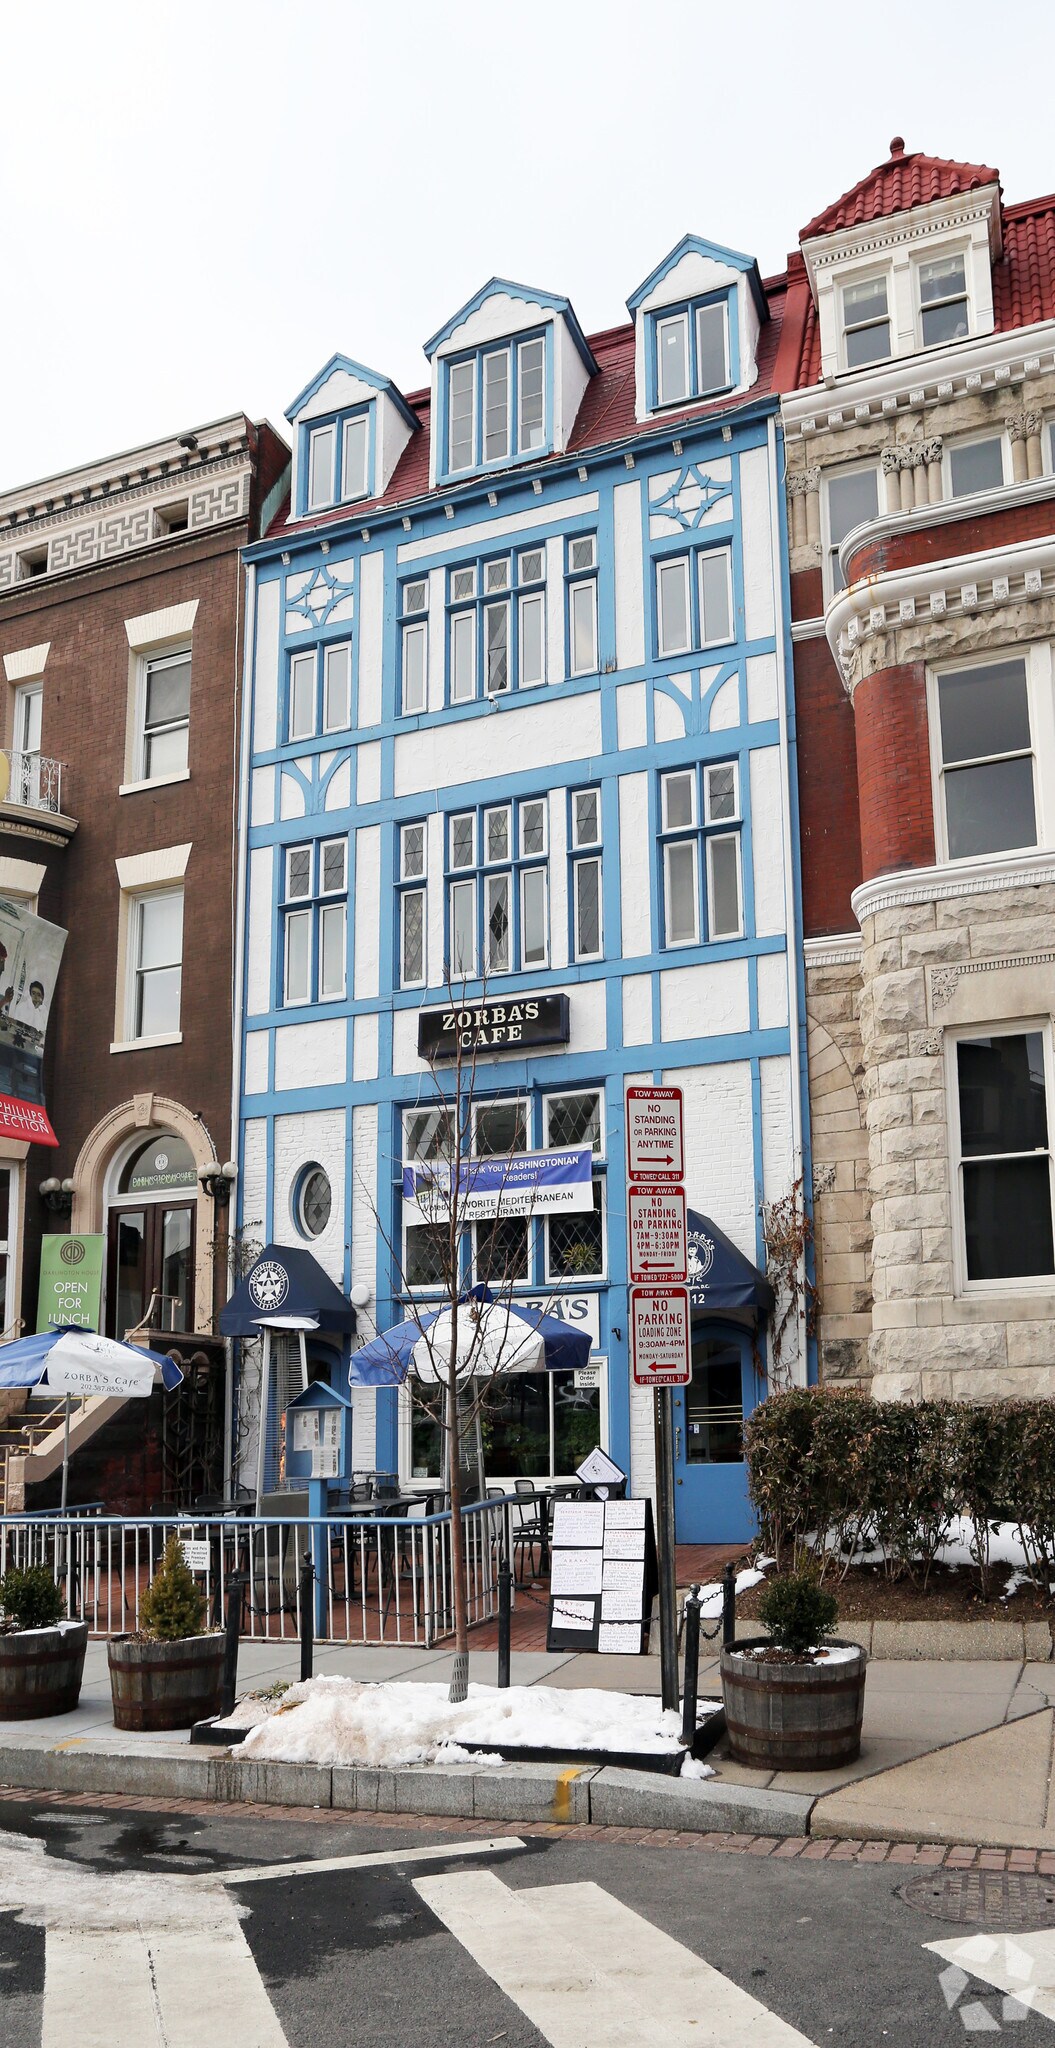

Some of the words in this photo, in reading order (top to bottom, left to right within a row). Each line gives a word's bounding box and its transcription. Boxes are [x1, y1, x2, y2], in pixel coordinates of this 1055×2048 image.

[442, 1002, 539, 1031] ZORBA'S
[459, 1024, 522, 1048] CAFE
[647, 1104, 661, 1113] NO
[634, 1115, 675, 1124] STANDING
[644, 1127, 677, 1136] PARKING
[637, 1140, 674, 1149] ANYTIME
[487, 1164, 503, 1173] You
[504, 1155, 579, 1171] WASHINGTONIAN
[499, 1192, 574, 1207] MEDITERRANEAN
[651, 1198, 663, 1207] NO
[638, 1209, 677, 1218] STANDING
[633, 1220, 644, 1229] OR
[647, 1220, 682, 1229] PARKING
[53, 1282, 88, 1293] OPEN
[58, 1297, 82, 1309] FOR
[652, 1300, 668, 1311] NO
[48, 1313, 90, 1325] LUNCH
[638, 1313, 683, 1325] PARKING
[639, 1327, 665, 1337] LOADING
[666, 1326, 682, 1337] ZONE
[64, 1372, 109, 1383] ZORBA'S
[663, 1375, 675, 1383] CALL
